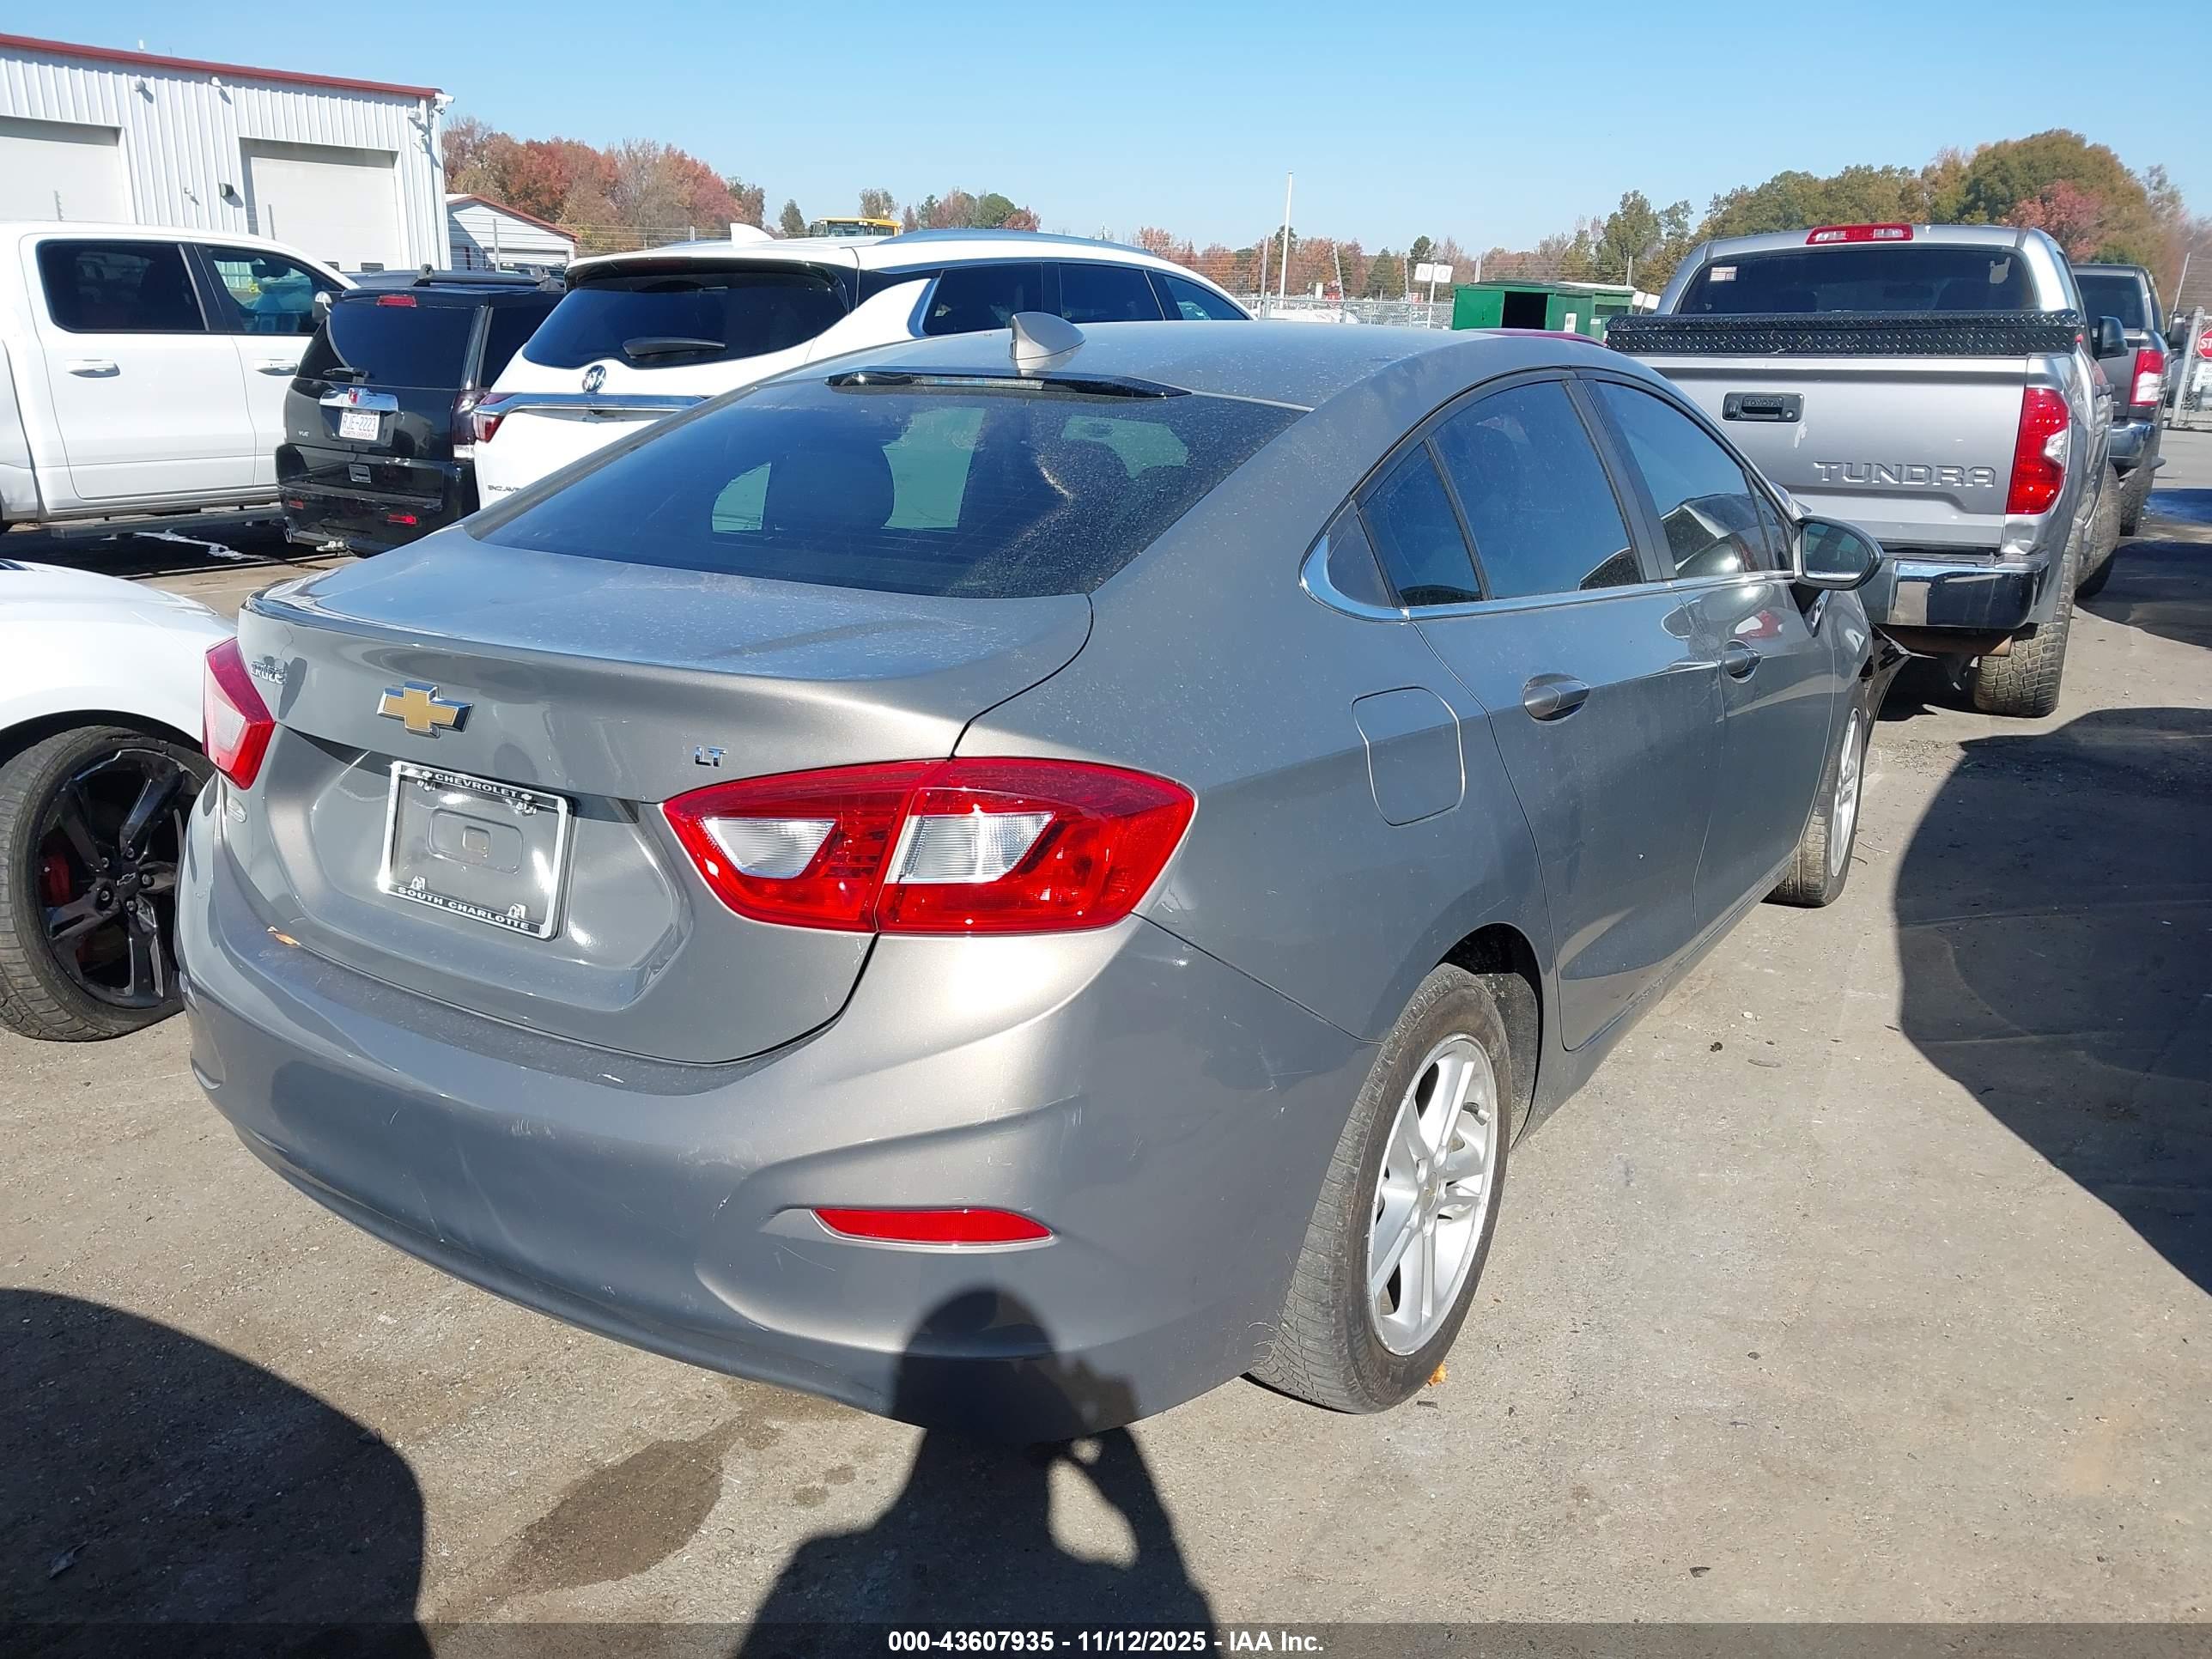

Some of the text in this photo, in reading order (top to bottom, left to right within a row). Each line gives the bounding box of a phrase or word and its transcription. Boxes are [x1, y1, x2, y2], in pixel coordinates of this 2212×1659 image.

[1744, 398, 1781, 407] TOYOTA
[343, 414, 376, 433] RJE-2223
[1813, 460, 1996, 489] TUNDRA
[694, 745, 729, 768] LT
[434, 773, 519, 799] CHEVROLET
[397, 885, 531, 931] SOUTH CHARLOTTE
